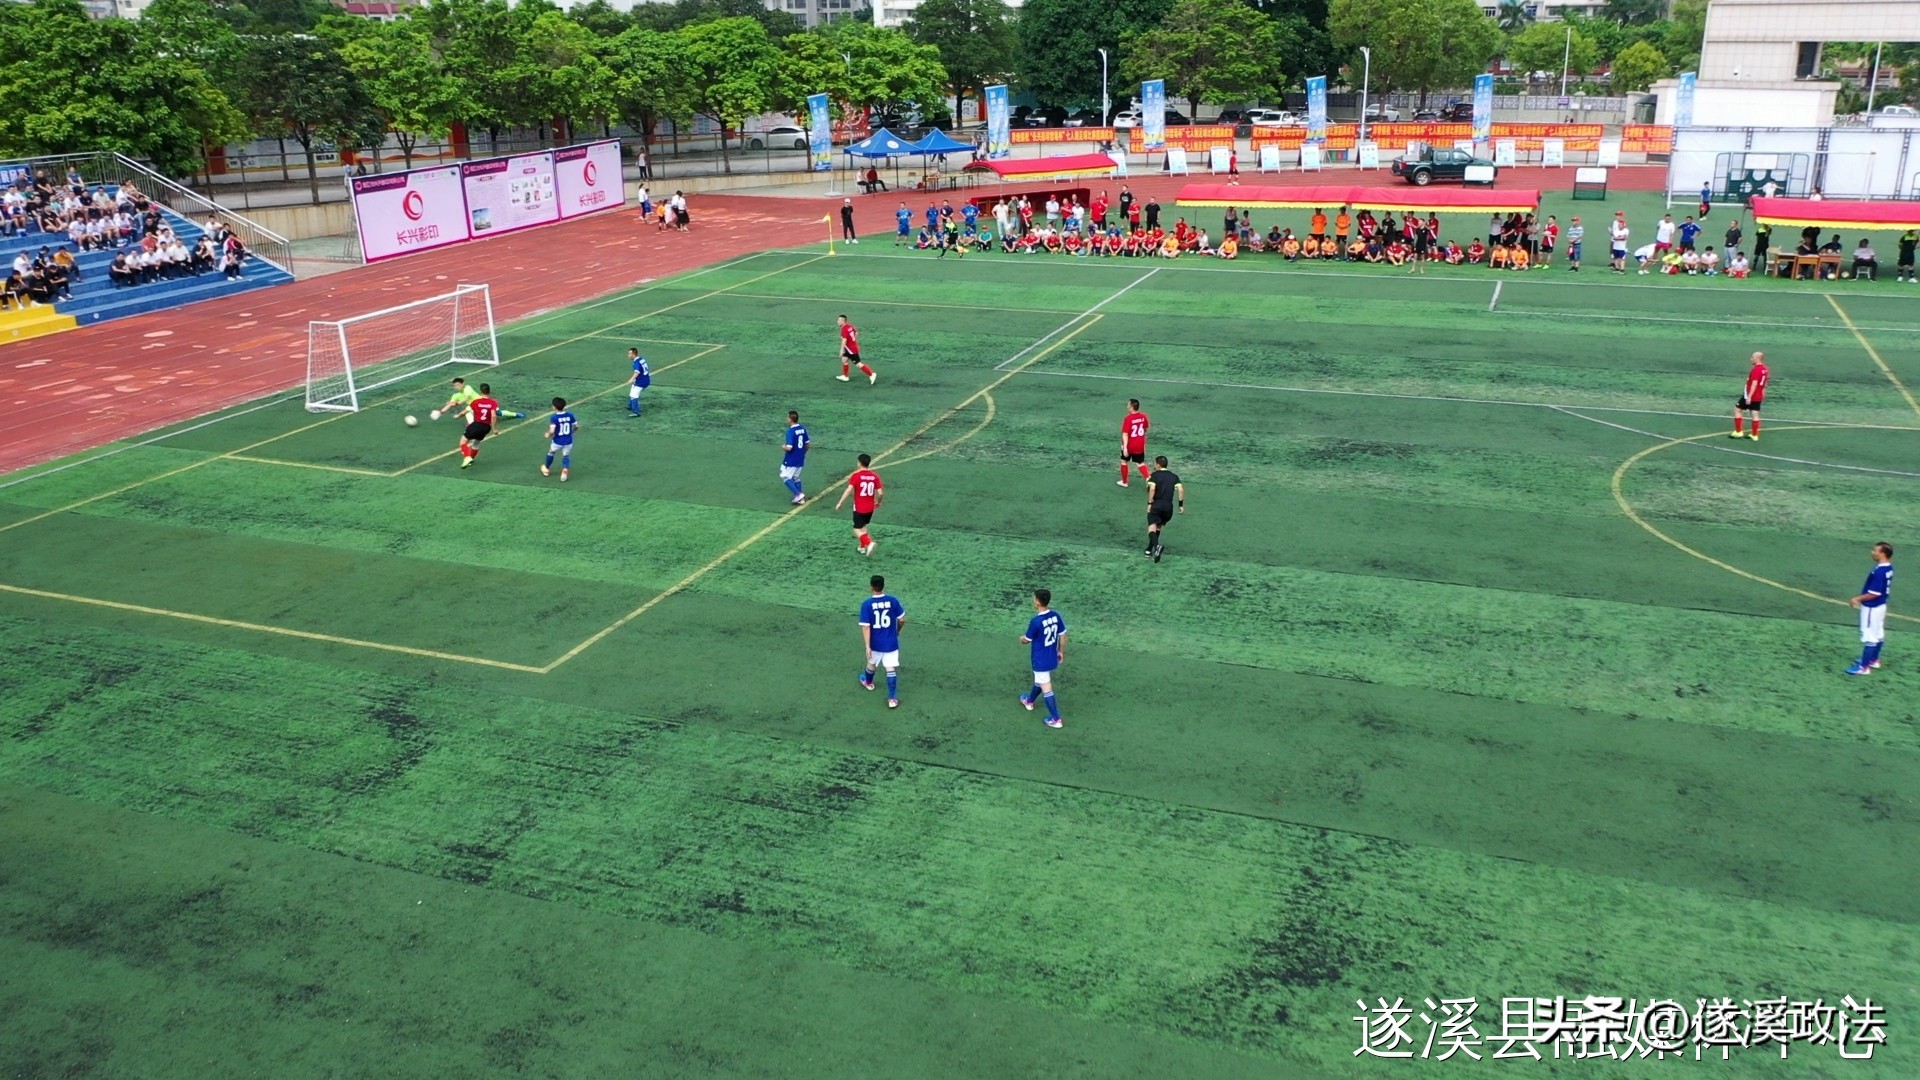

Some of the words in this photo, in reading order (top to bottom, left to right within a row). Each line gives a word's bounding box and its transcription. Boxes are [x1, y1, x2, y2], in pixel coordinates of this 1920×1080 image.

[480, 408, 489, 420] 2
[558, 422, 571, 436] 10
[1130, 424, 1145, 437] 26
[797, 434, 804, 449] 8
[859, 481, 875, 497] 20
[872, 609, 891, 629] 16
